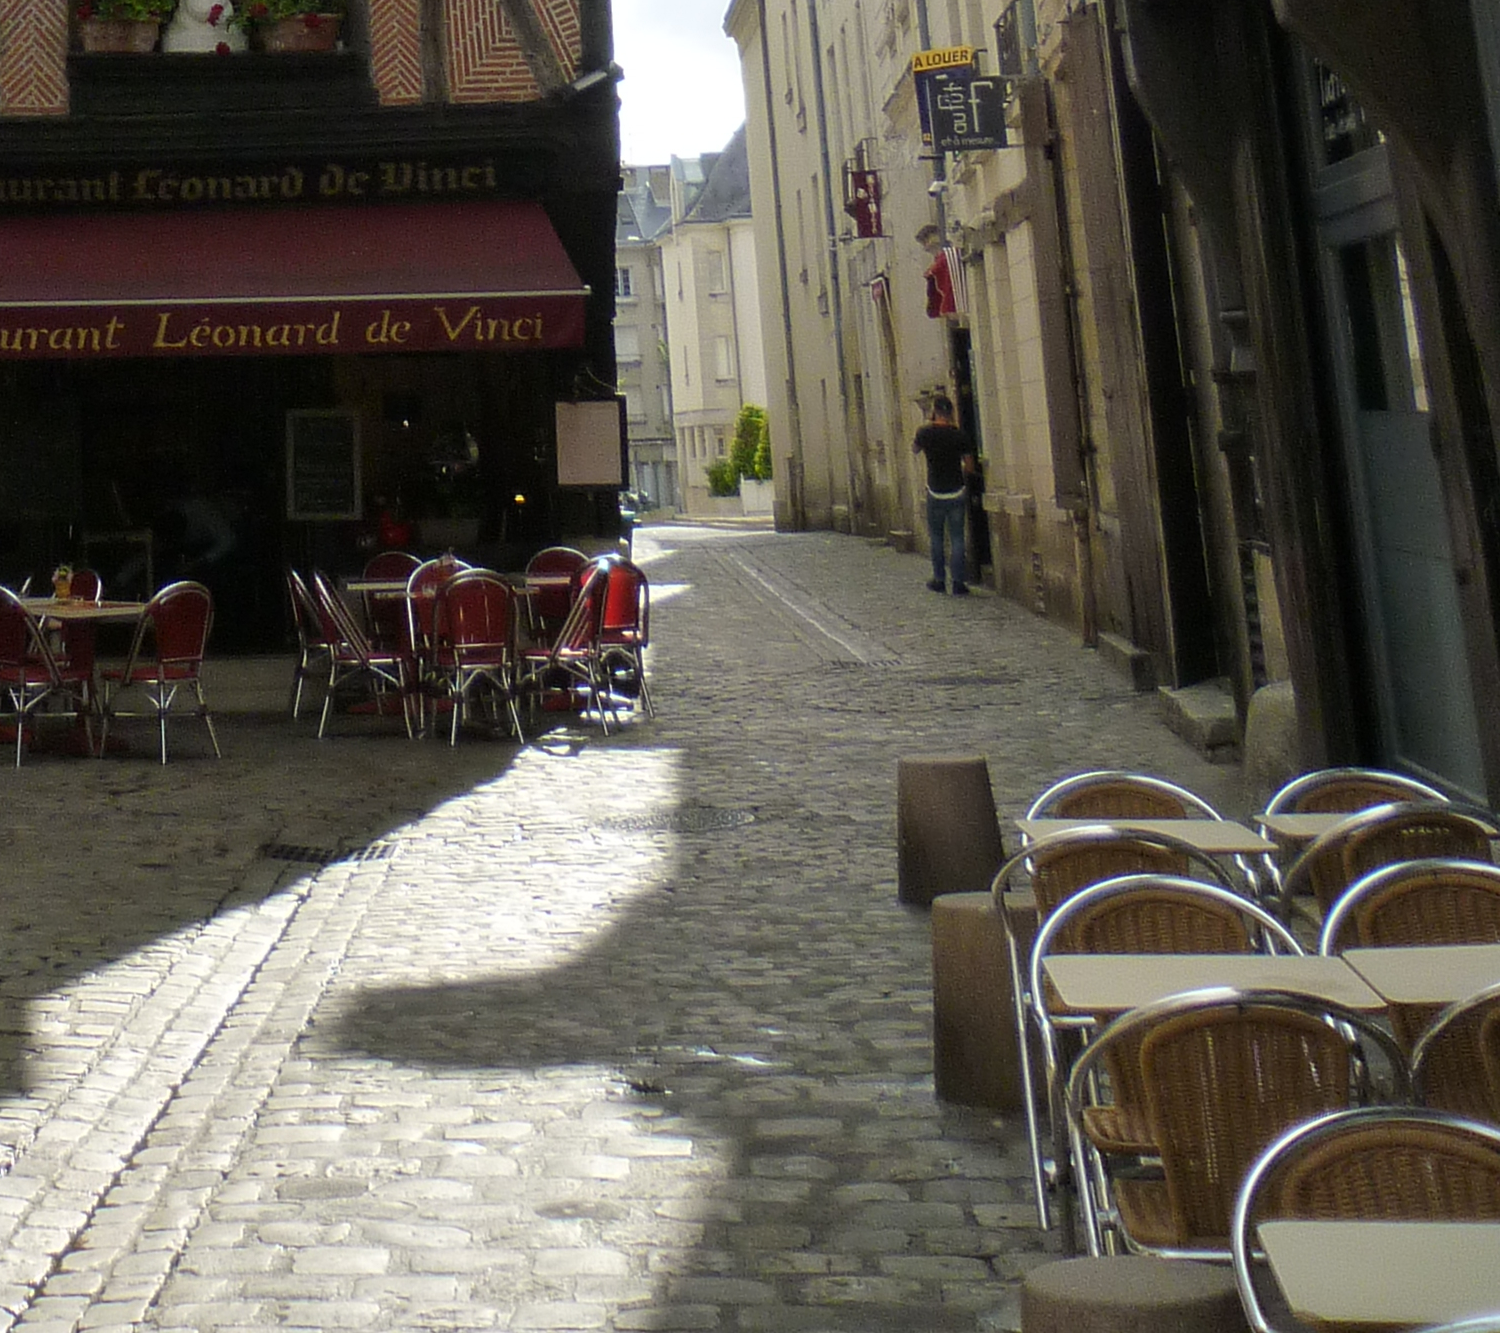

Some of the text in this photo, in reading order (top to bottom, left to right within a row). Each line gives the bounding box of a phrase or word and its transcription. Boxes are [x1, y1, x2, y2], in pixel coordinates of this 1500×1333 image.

[926, 49, 969, 66] LOUER
[318, 162, 370, 197] de
[378, 158, 497, 193] Vinci
[151, 309, 341, 349] Léonard
[364, 309, 412, 345] de
[433, 305, 544, 342] Vinci
